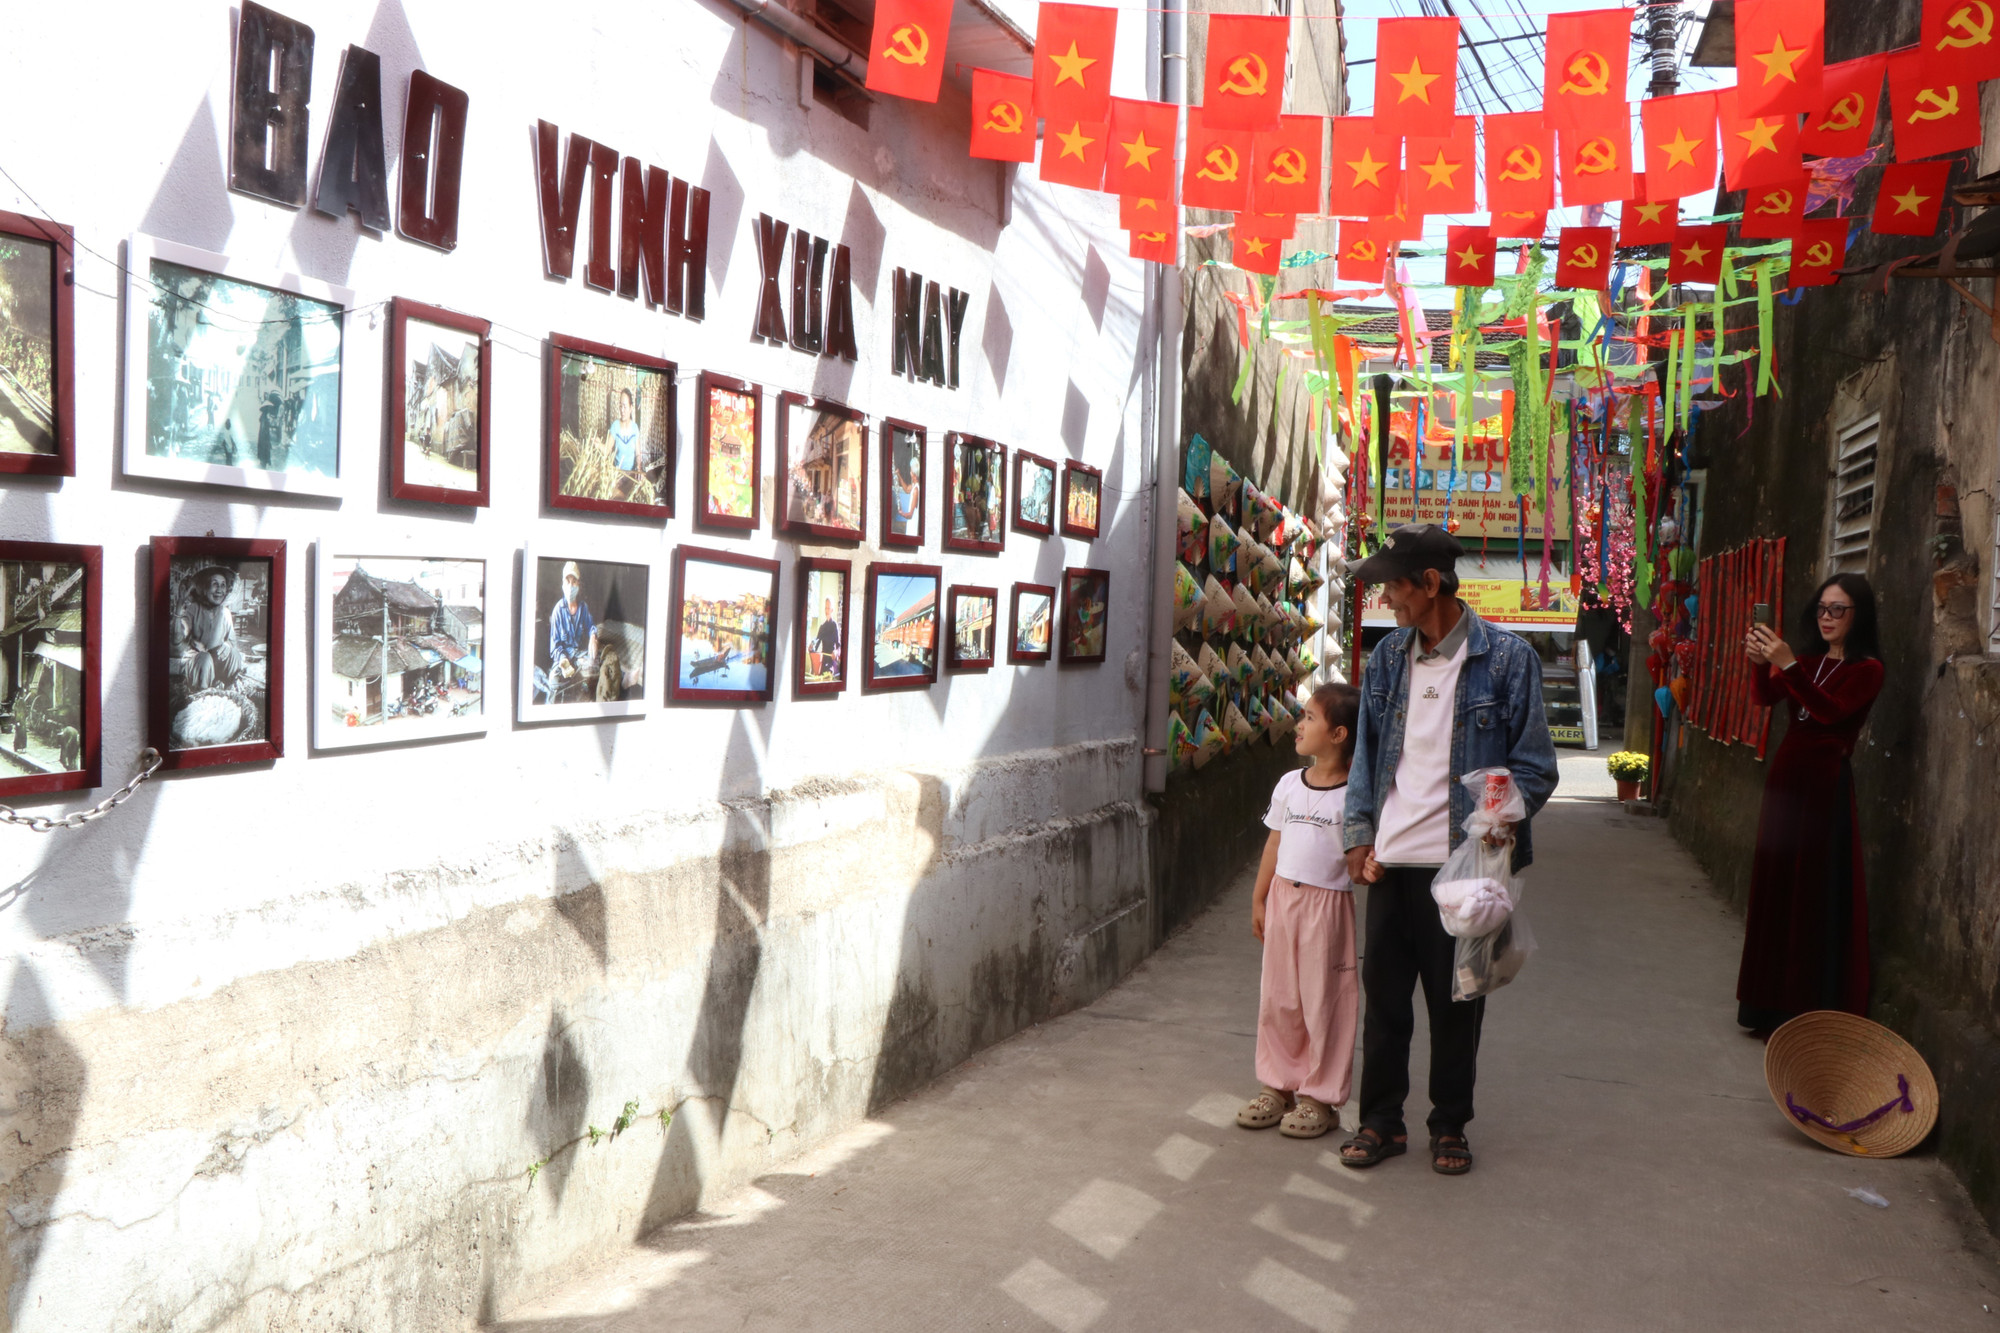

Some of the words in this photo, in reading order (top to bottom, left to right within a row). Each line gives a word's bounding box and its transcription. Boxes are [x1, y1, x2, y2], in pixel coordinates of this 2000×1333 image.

[228, 0, 470, 253] BAO
[536, 118, 711, 322] VINH
[893, 265, 971, 389] NAY
